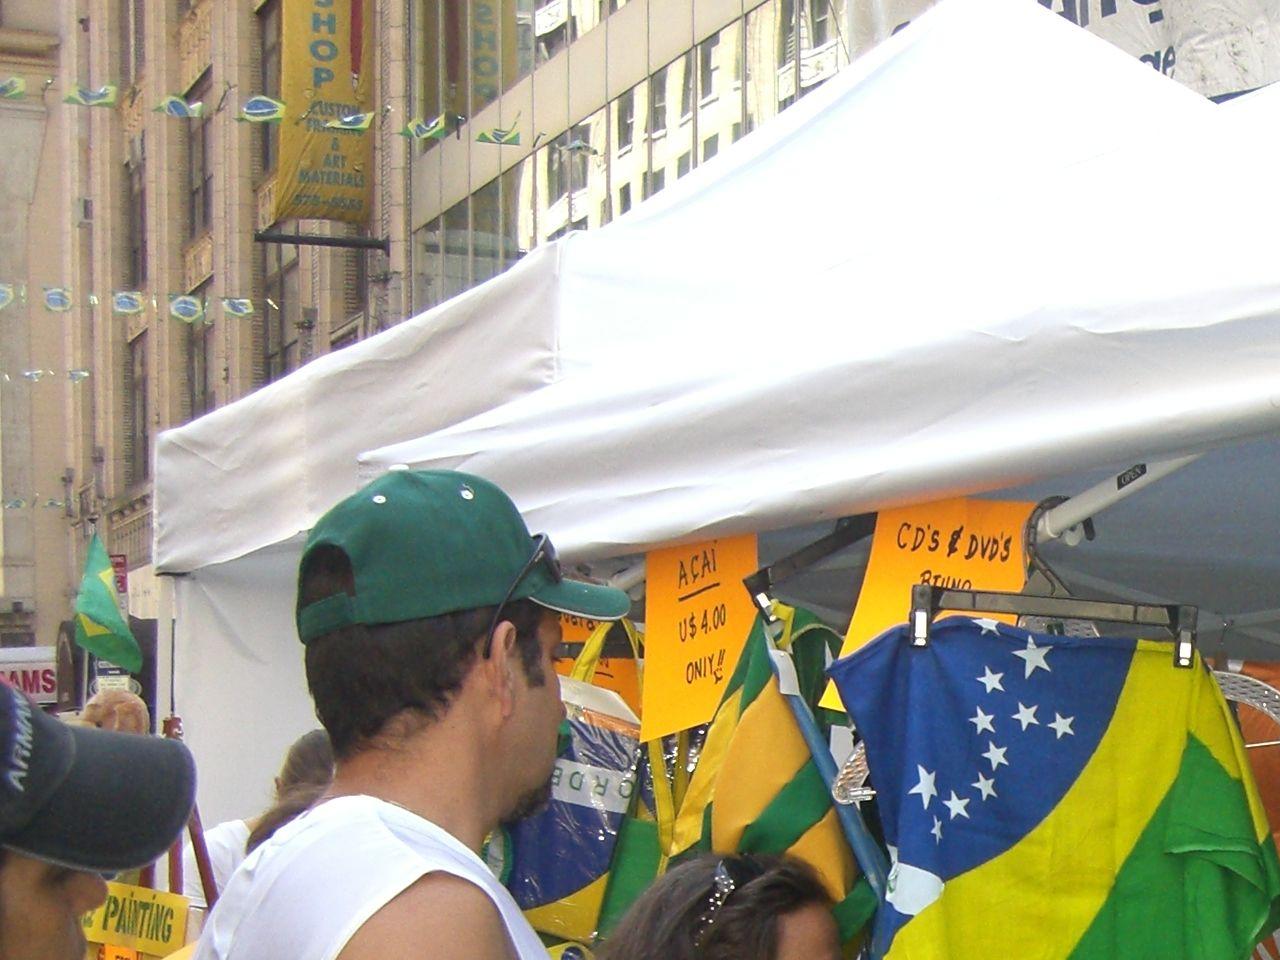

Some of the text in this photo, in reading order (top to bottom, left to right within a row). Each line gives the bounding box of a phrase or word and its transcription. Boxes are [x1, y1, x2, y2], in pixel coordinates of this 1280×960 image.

[323, 154, 347, 168] ART
[299, 170, 365, 188] MATERIALS
[103, 892, 174, 943] PAINTING
